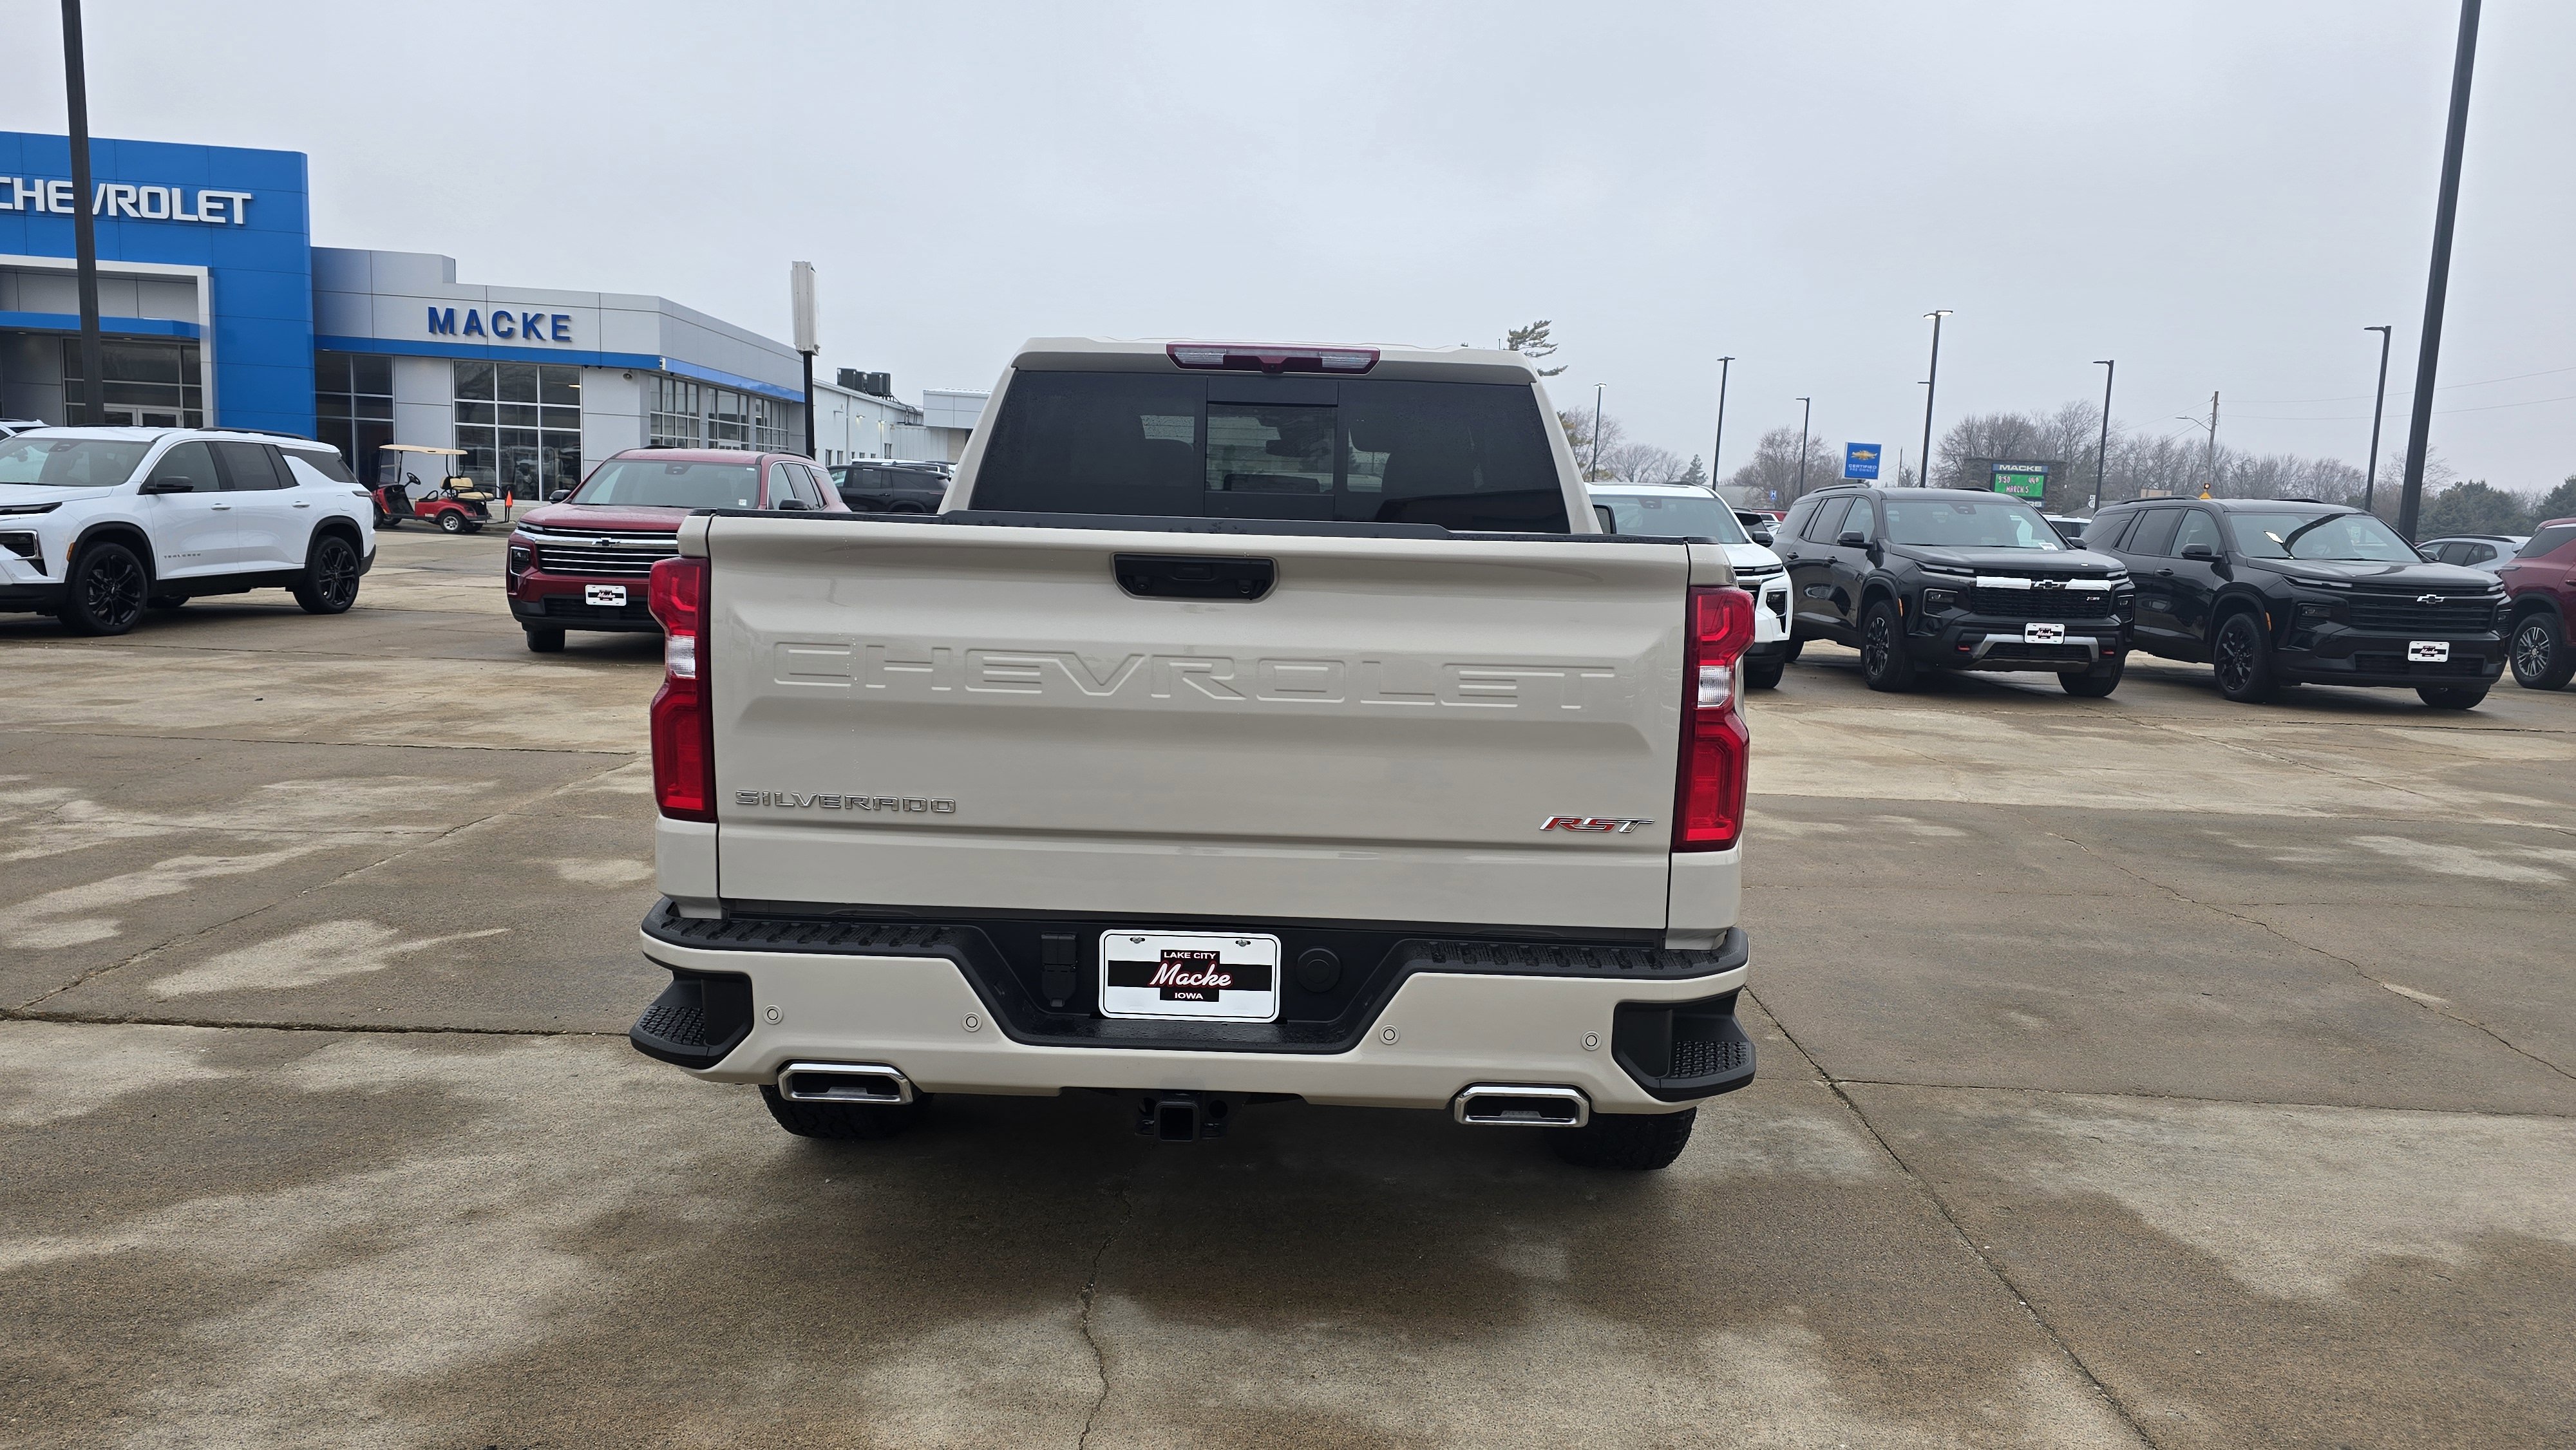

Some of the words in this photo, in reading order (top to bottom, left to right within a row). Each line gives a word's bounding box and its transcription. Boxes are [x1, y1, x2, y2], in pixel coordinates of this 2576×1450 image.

[428, 306, 572, 342] MACKE
[2006, 485, 2024, 493] MARCH
[773, 642, 1615, 709] CHEVROLET
[736, 790, 956, 813] SILVERADO
[1539, 815, 1655, 833] RST
[1149, 962, 1231, 987] Macke
